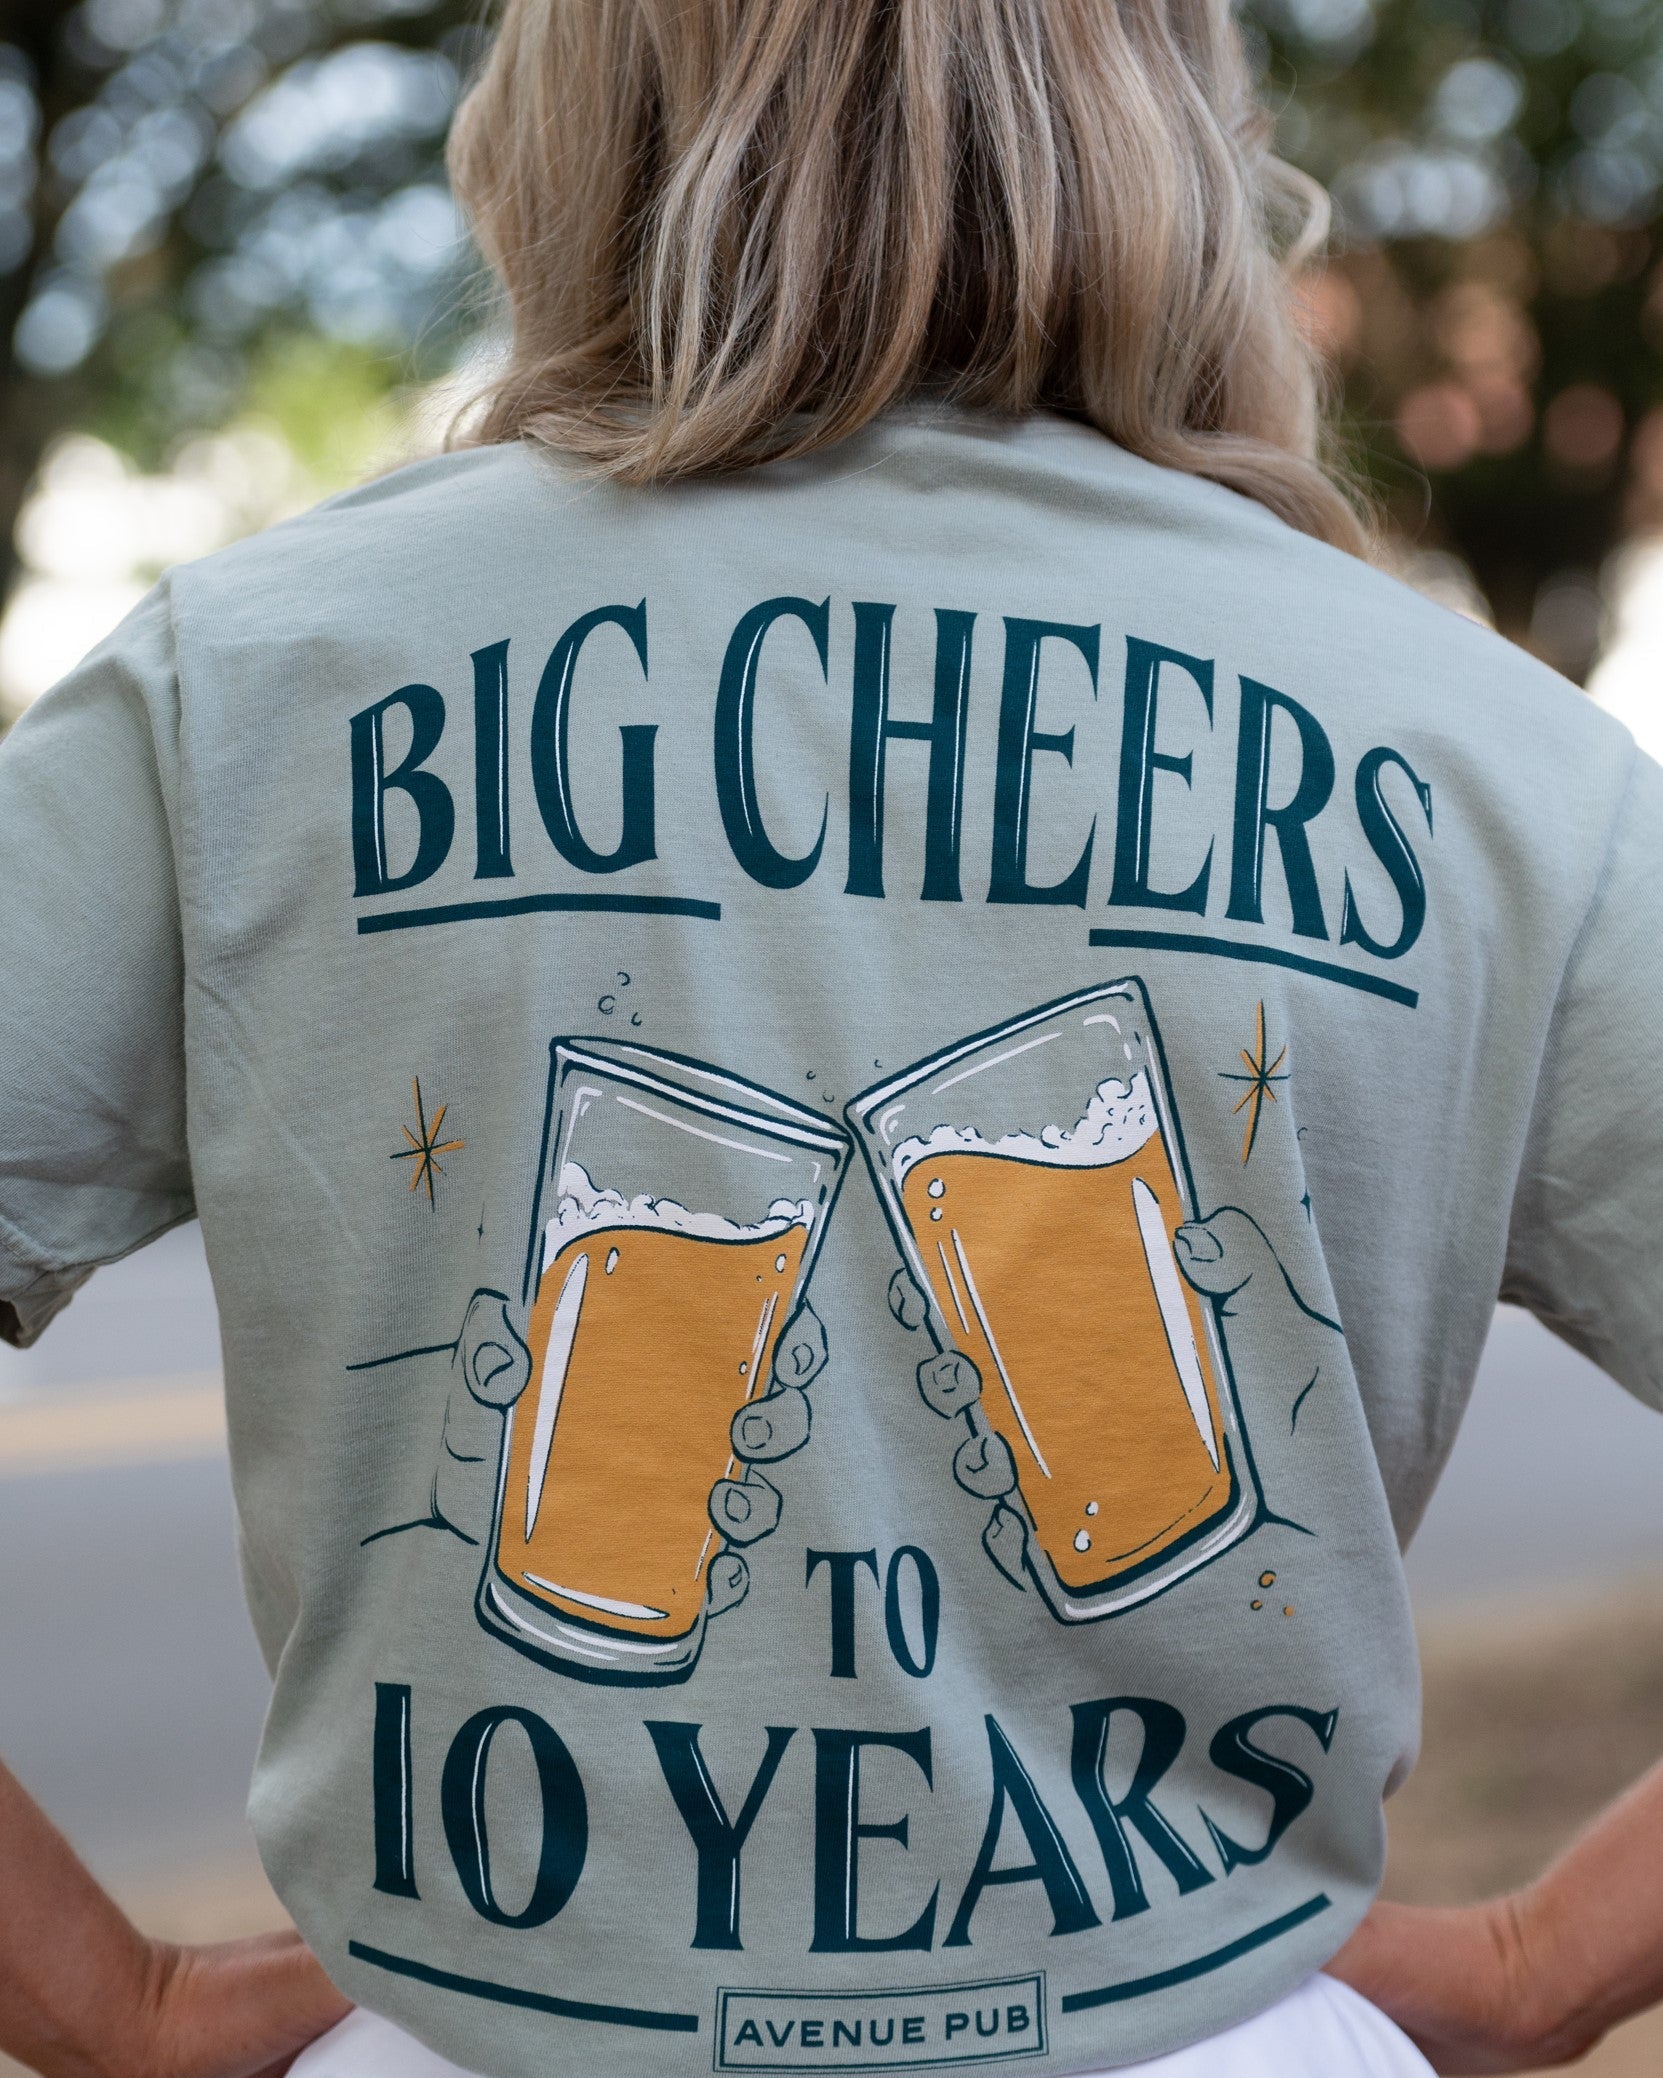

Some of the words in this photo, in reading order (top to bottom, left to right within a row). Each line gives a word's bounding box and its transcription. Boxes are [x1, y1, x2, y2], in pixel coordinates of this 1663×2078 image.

[348, 596, 660, 898] BIG
[714, 595, 1434, 960] CHEERS
[805, 1546, 940, 1680] TO
[372, 1681, 589, 1930] 10
[642, 1698, 1340, 1954] YEARS
[733, 2016, 926, 2048] AVENUE
[945, 2004, 1030, 2041] PUB
